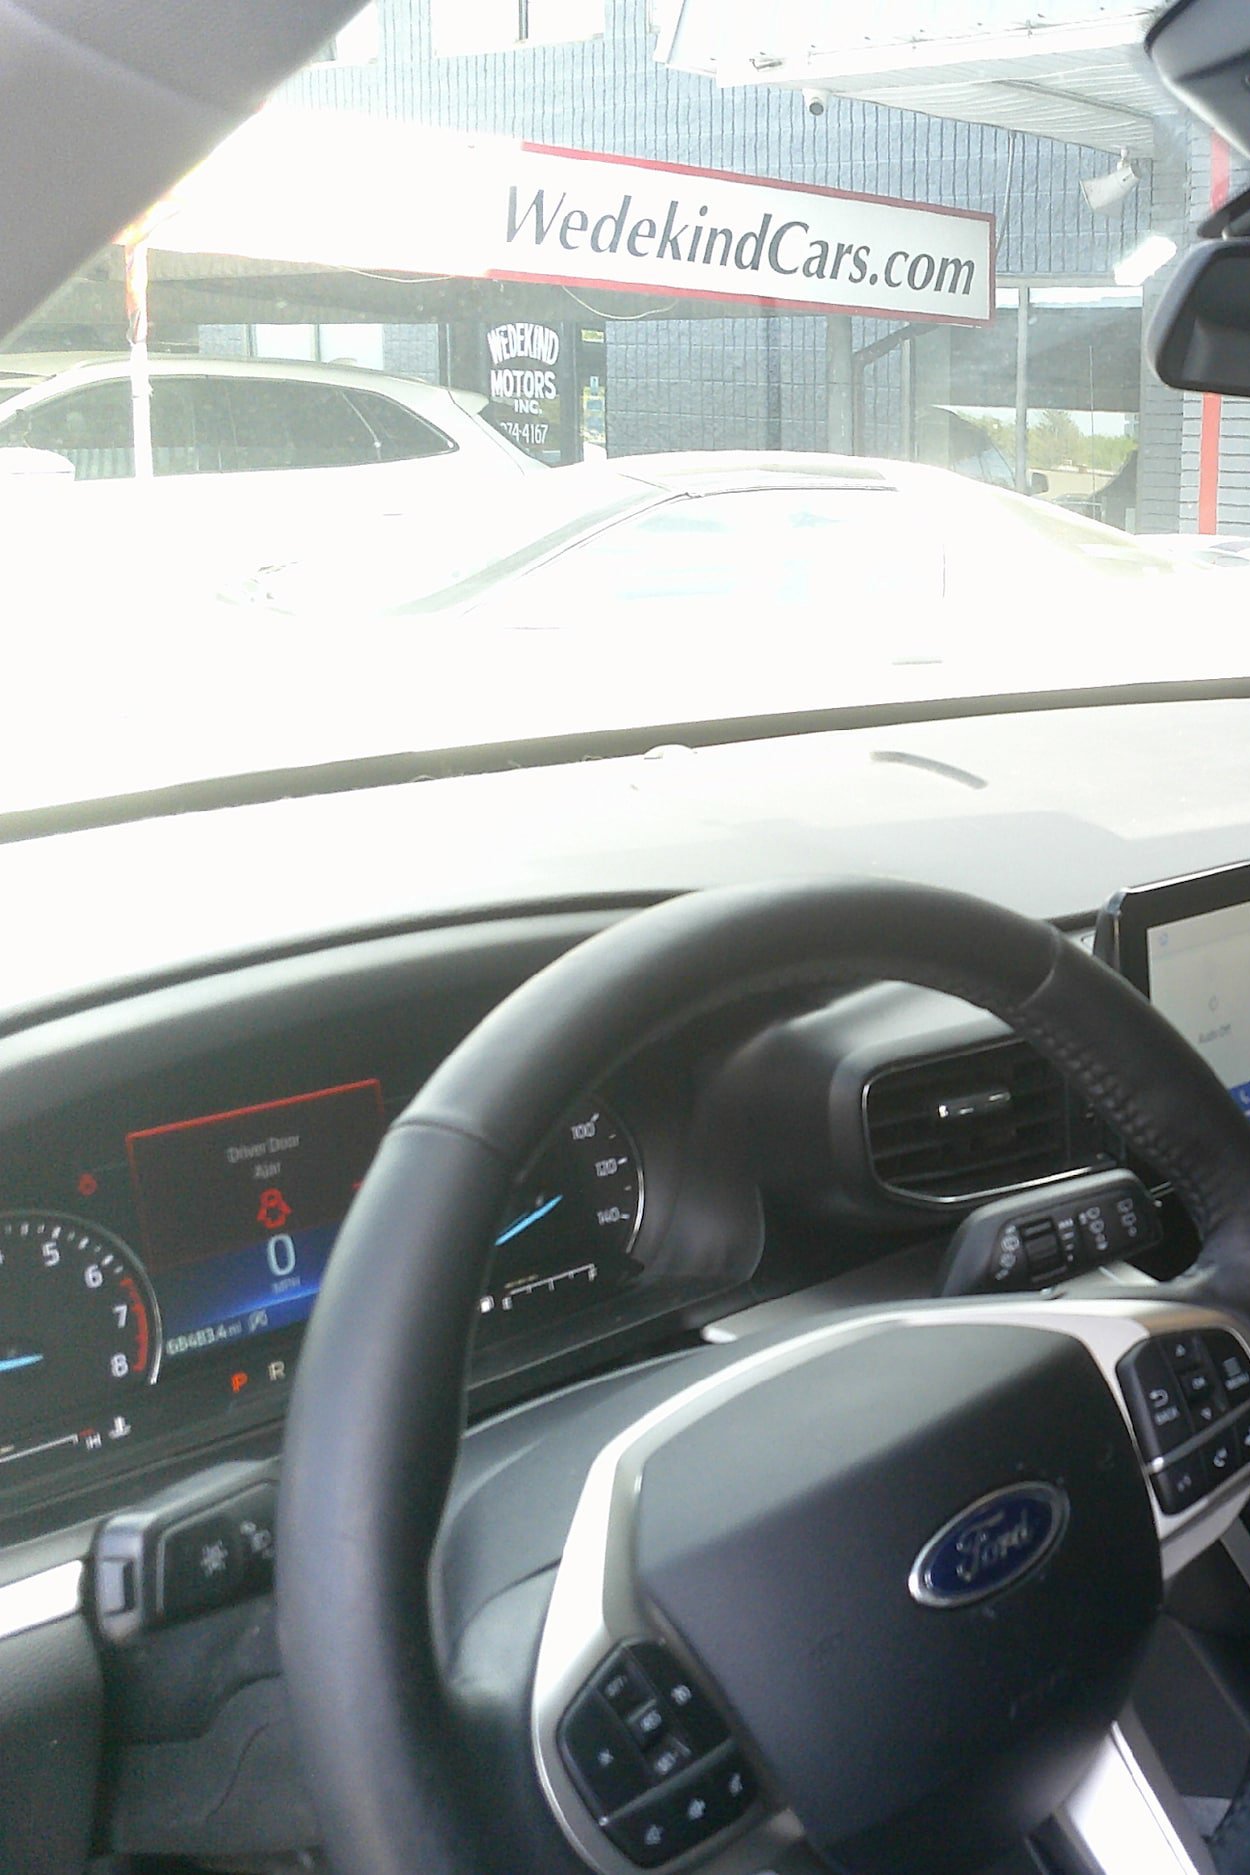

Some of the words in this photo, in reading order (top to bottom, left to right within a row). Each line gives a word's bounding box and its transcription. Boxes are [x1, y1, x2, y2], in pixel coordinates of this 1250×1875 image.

[506, 185, 976, 296] WedekindCars.com
[487, 322, 560, 366] WEDEKIND
[490, 369, 557, 400] MOTORS
[514, 399, 543, 415] INC.
[571, 1121, 596, 1140] 100
[41, 1241, 61, 1267] 5
[267, 1233, 297, 1276] 0
[84, 1263, 104, 1289] 6
[111, 1303, 129, 1329] 7
[110, 1353, 129, 1378] 8
[267, 1360, 287, 1382] R
[231, 1371, 249, 1393] P
[955, 1508, 1029, 1583] Ford
